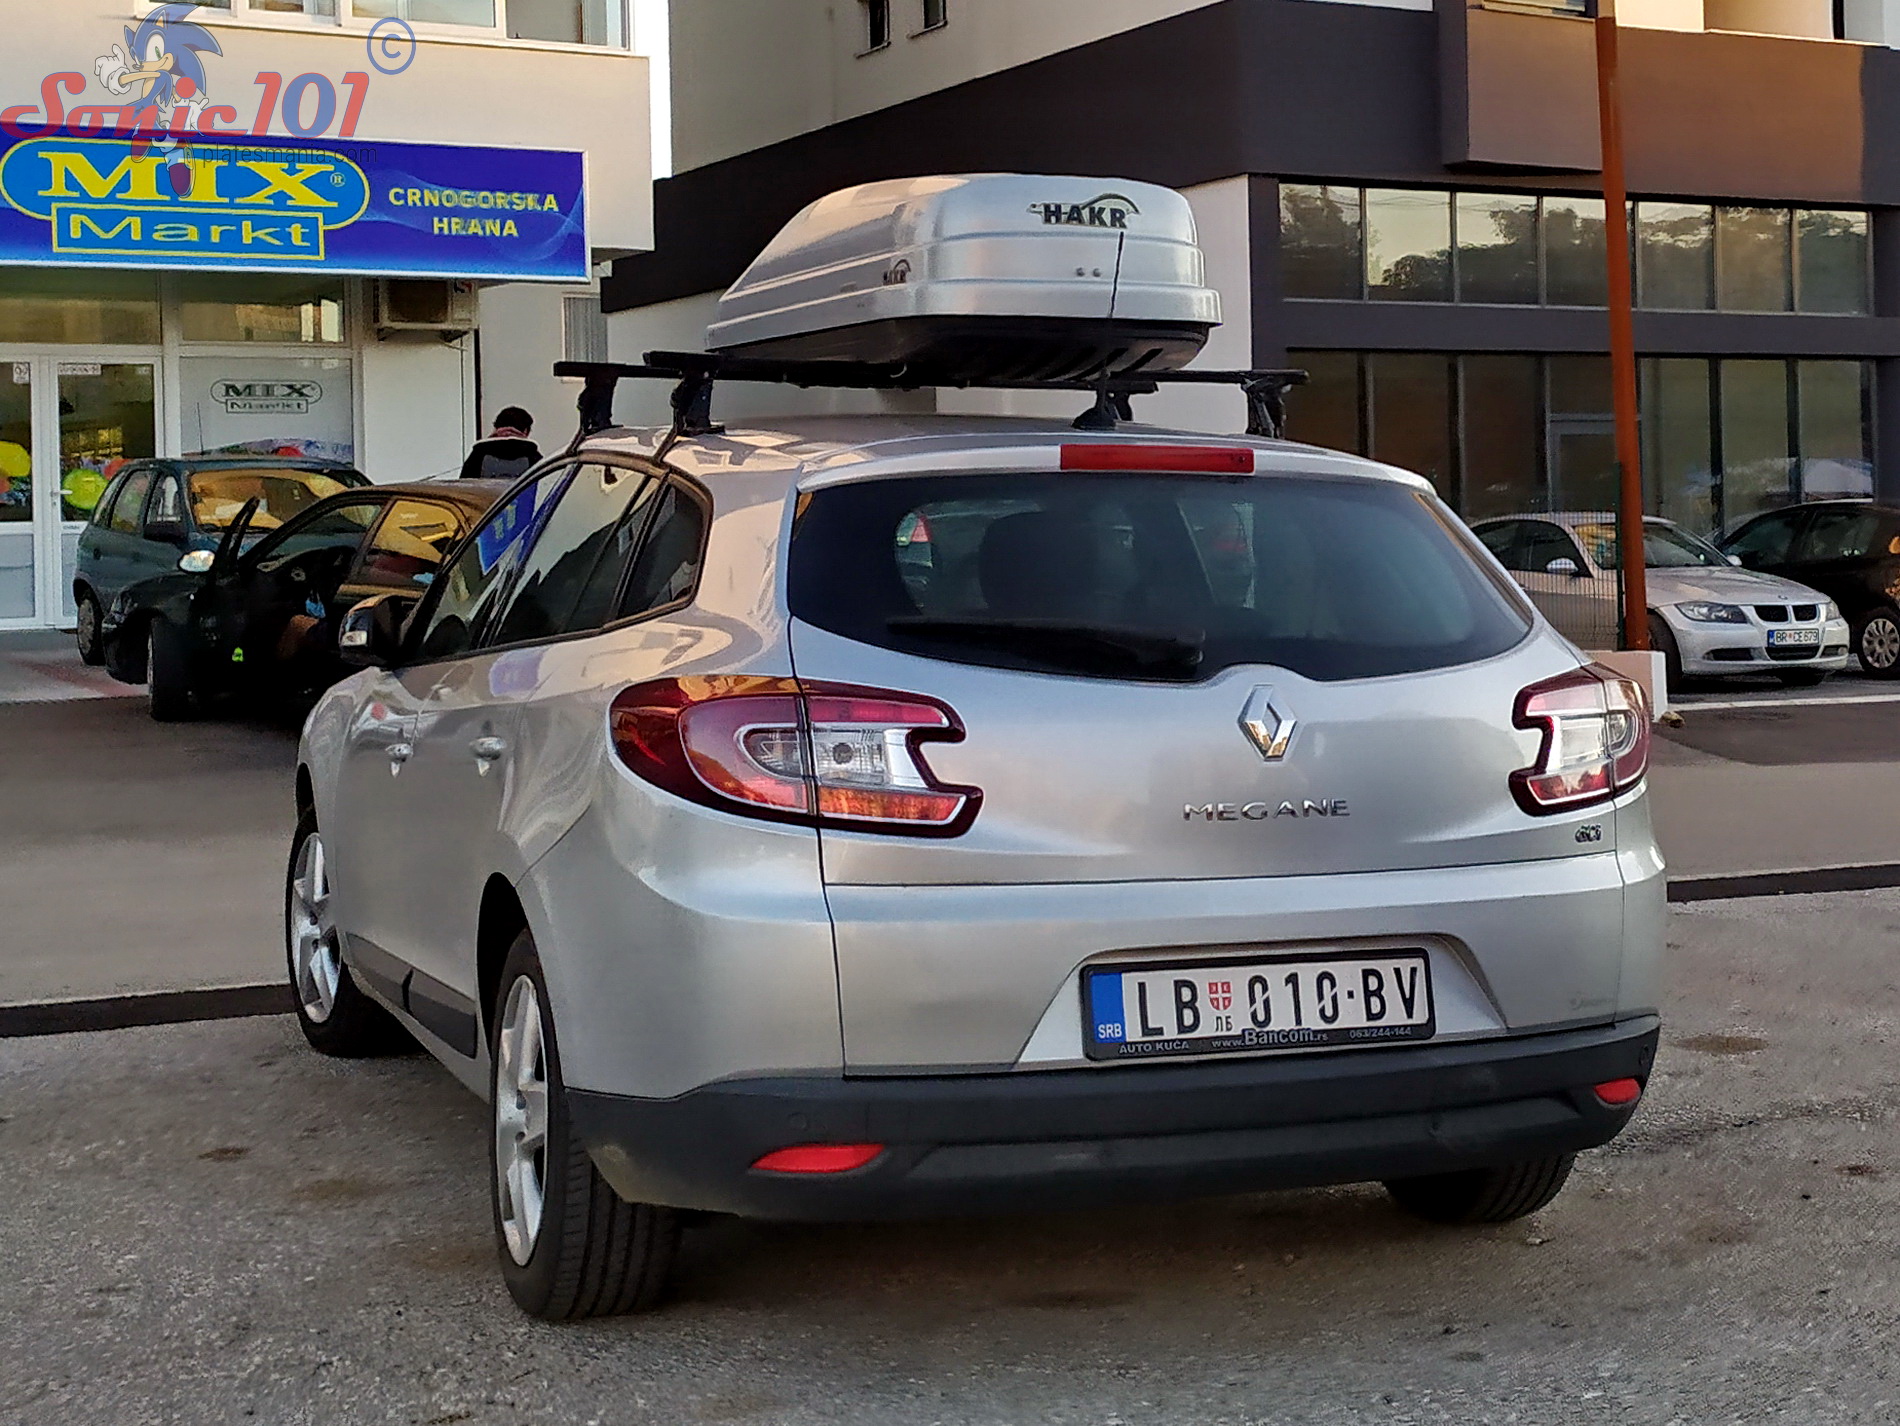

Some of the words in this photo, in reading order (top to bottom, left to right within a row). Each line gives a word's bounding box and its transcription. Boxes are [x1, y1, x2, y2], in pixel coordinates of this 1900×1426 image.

[38, 151, 338, 207] MIX
[388, 190, 560, 213] CRNOGORSKA
[433, 216, 519, 238] HRANA
[1043, 203, 1127, 229] HAKR
[69, 213, 311, 246] Markt
[222, 383, 313, 398] MIX
[1183, 799, 1350, 822] MEGANE
[1137, 978, 1202, 1038] LB
[1097, 1022, 1124, 1040] SRB
[1214, 1014, 1234, 1033] ЛБ
[1119, 1042, 1153, 1054] AUTO
